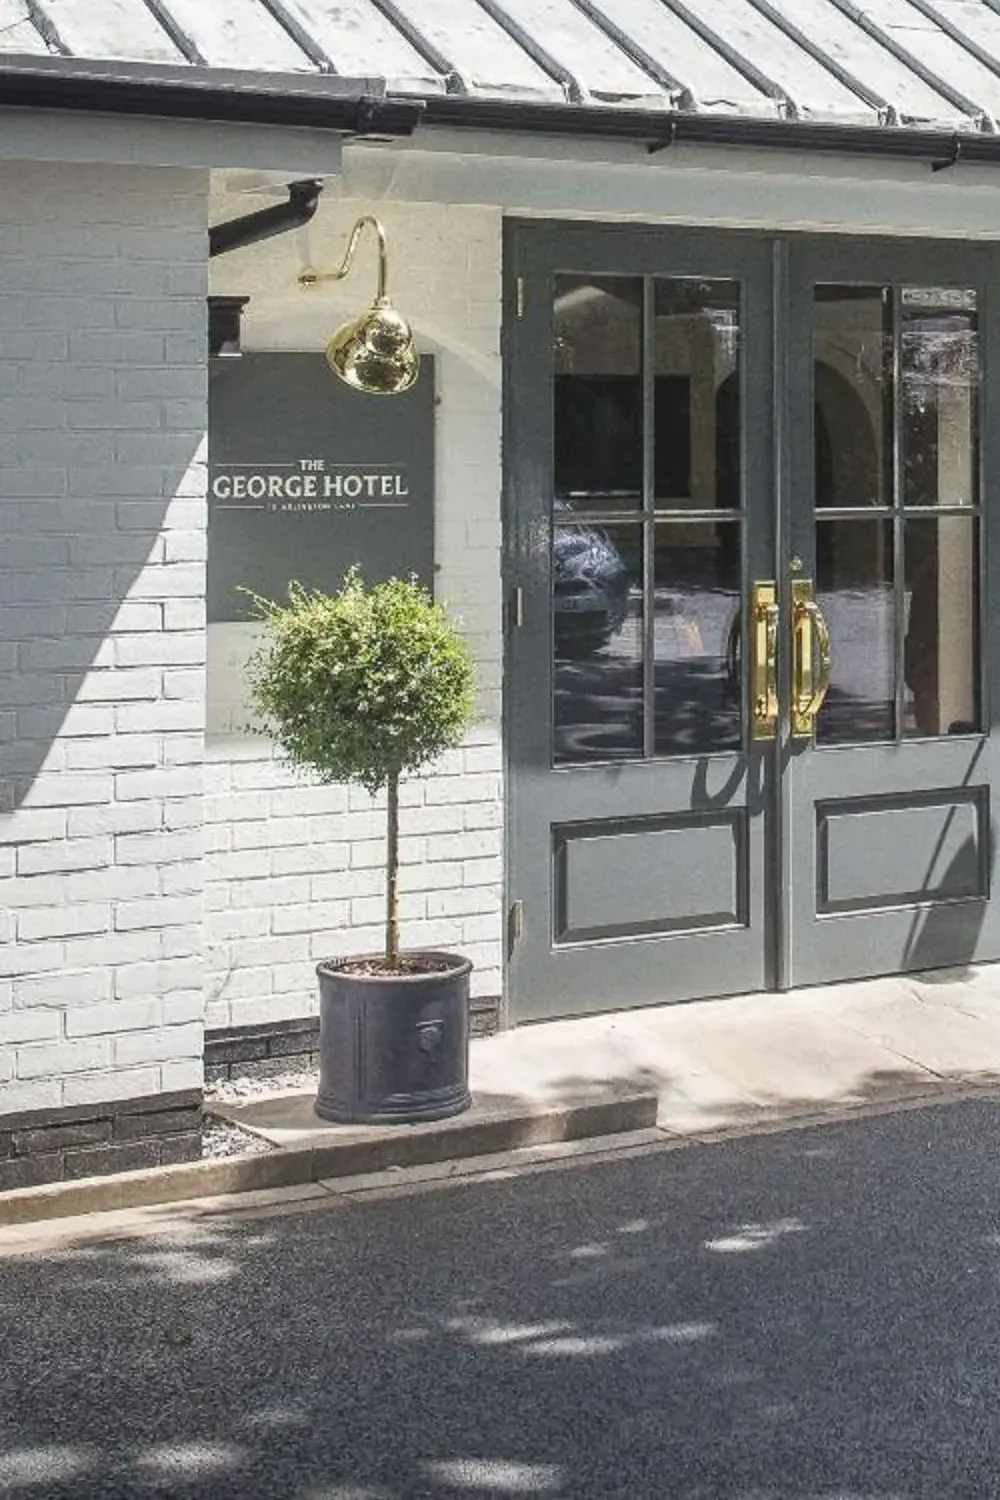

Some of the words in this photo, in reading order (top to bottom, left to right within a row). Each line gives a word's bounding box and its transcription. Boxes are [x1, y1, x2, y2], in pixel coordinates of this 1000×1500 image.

[298, 459, 325, 471] THE
[212, 475, 317, 499] GEORGE
[323, 475, 409, 497] HOTEL
